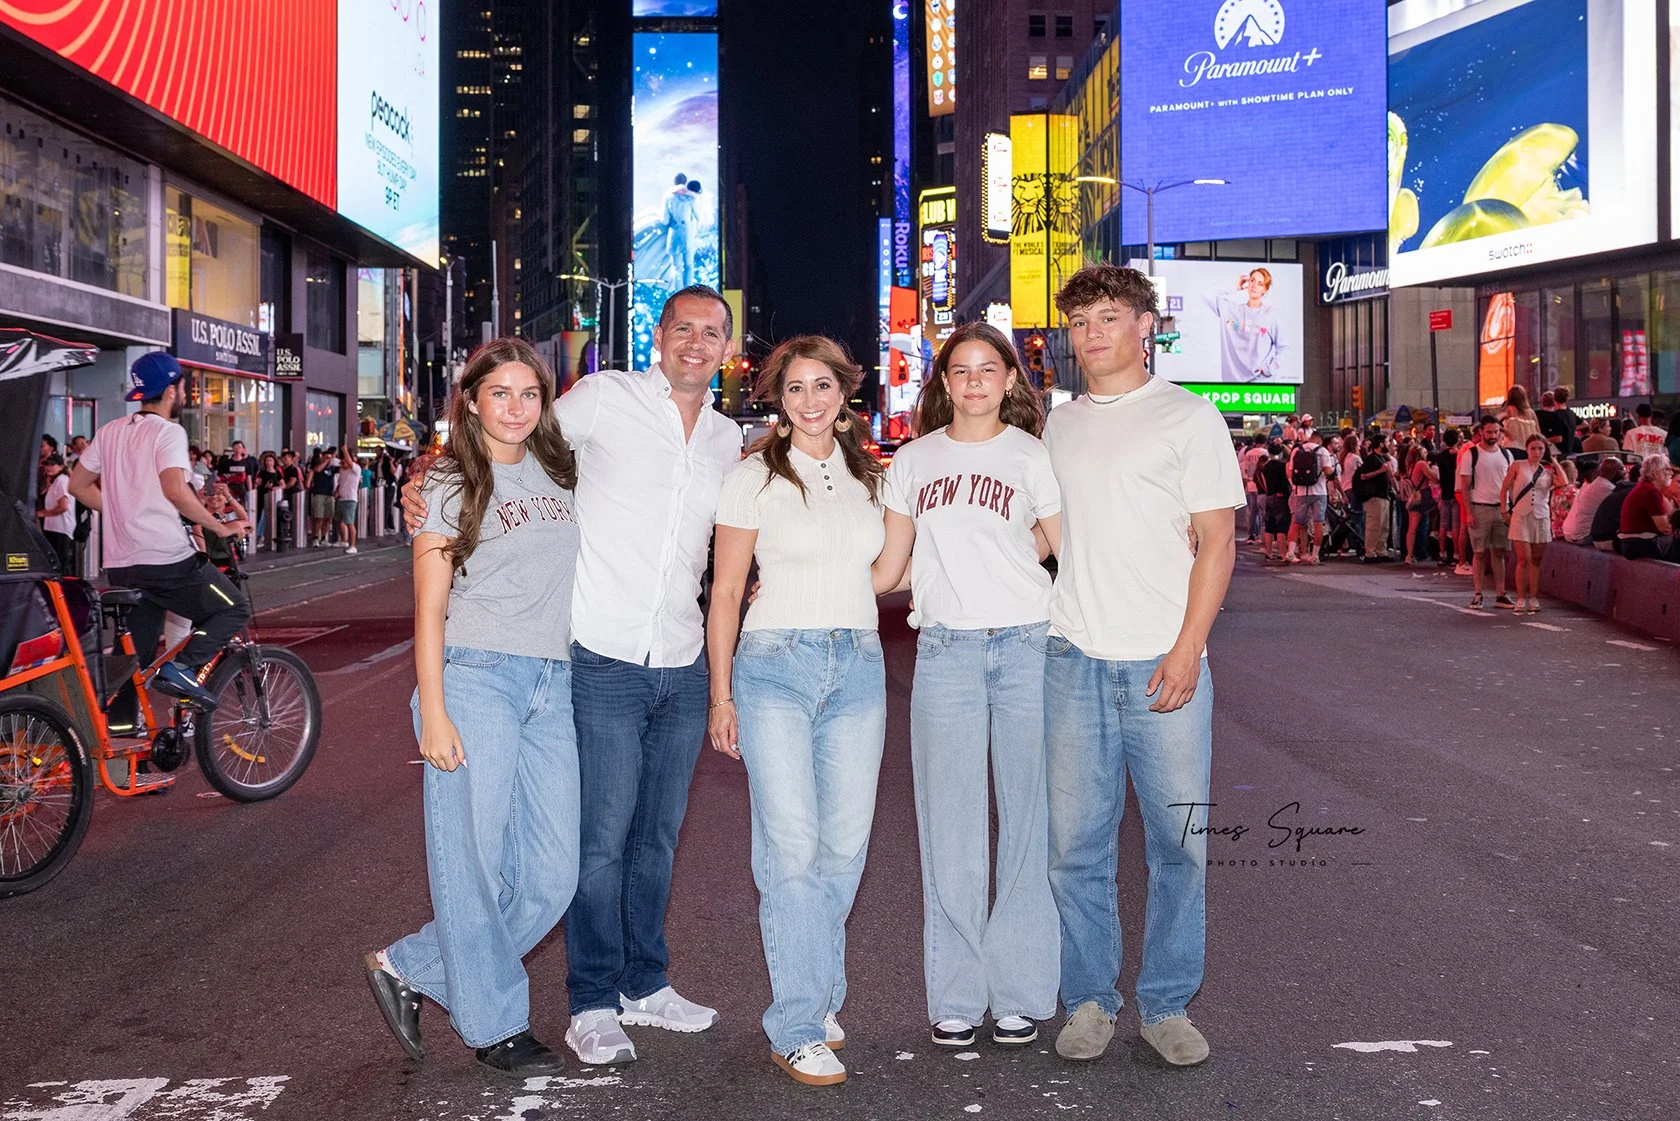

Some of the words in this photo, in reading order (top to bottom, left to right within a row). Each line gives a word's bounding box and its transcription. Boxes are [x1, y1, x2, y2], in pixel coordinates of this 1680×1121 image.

[1179, 47, 1322, 88] Paramount+
[1218, 99, 1238, 107] WITH
[1241, 92, 1294, 105] SHOWTIME
[1297, 89, 1325, 99] PLAN
[1327, 86, 1354, 97] ONLY
[371, 90, 410, 144] peacock
[1488, 243, 1526, 261] swatch
[1323, 261, 1391, 302] Paramoun
[191, 318, 209, 346] U.S.
[209, 323, 236, 352] POLO
[235, 329, 262, 357] ASSN.
[276, 348, 292, 356] U.S.
[276, 355, 300, 364] POLO
[276, 363, 302, 372] ASSN.
[1570, 403, 1610, 419] watch
[915, 474, 962, 520] NEW
[967, 473, 1015, 522] YORK
[495, 498, 533, 536] NEW
[530, 496, 579, 526] YORK
